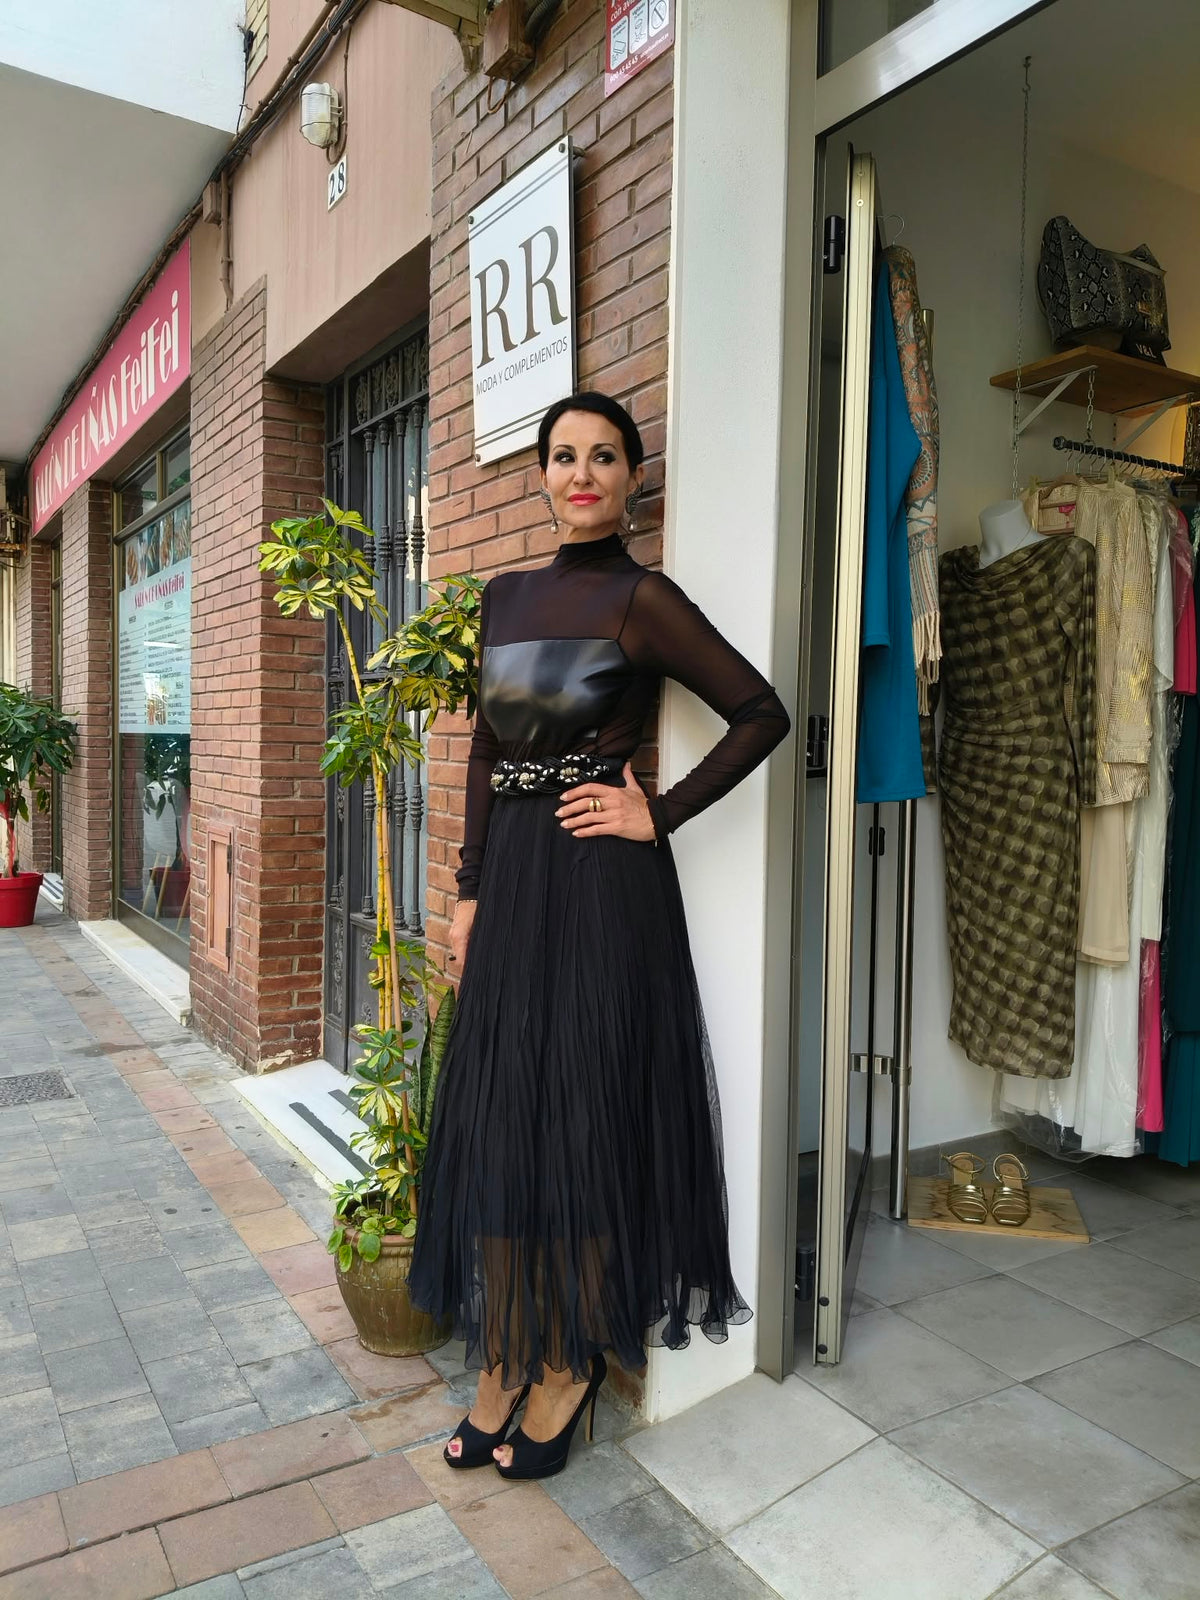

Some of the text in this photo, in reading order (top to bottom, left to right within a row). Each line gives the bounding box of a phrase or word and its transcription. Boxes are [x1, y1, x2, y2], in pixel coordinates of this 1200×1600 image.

[329, 161, 345, 205] 28
[474, 225, 568, 369] RR
[476, 336, 568, 396] MODA Y COMPLEMENTOS
[64, 424, 79, 490] DE
[81, 373, 118, 470] UÑAS
